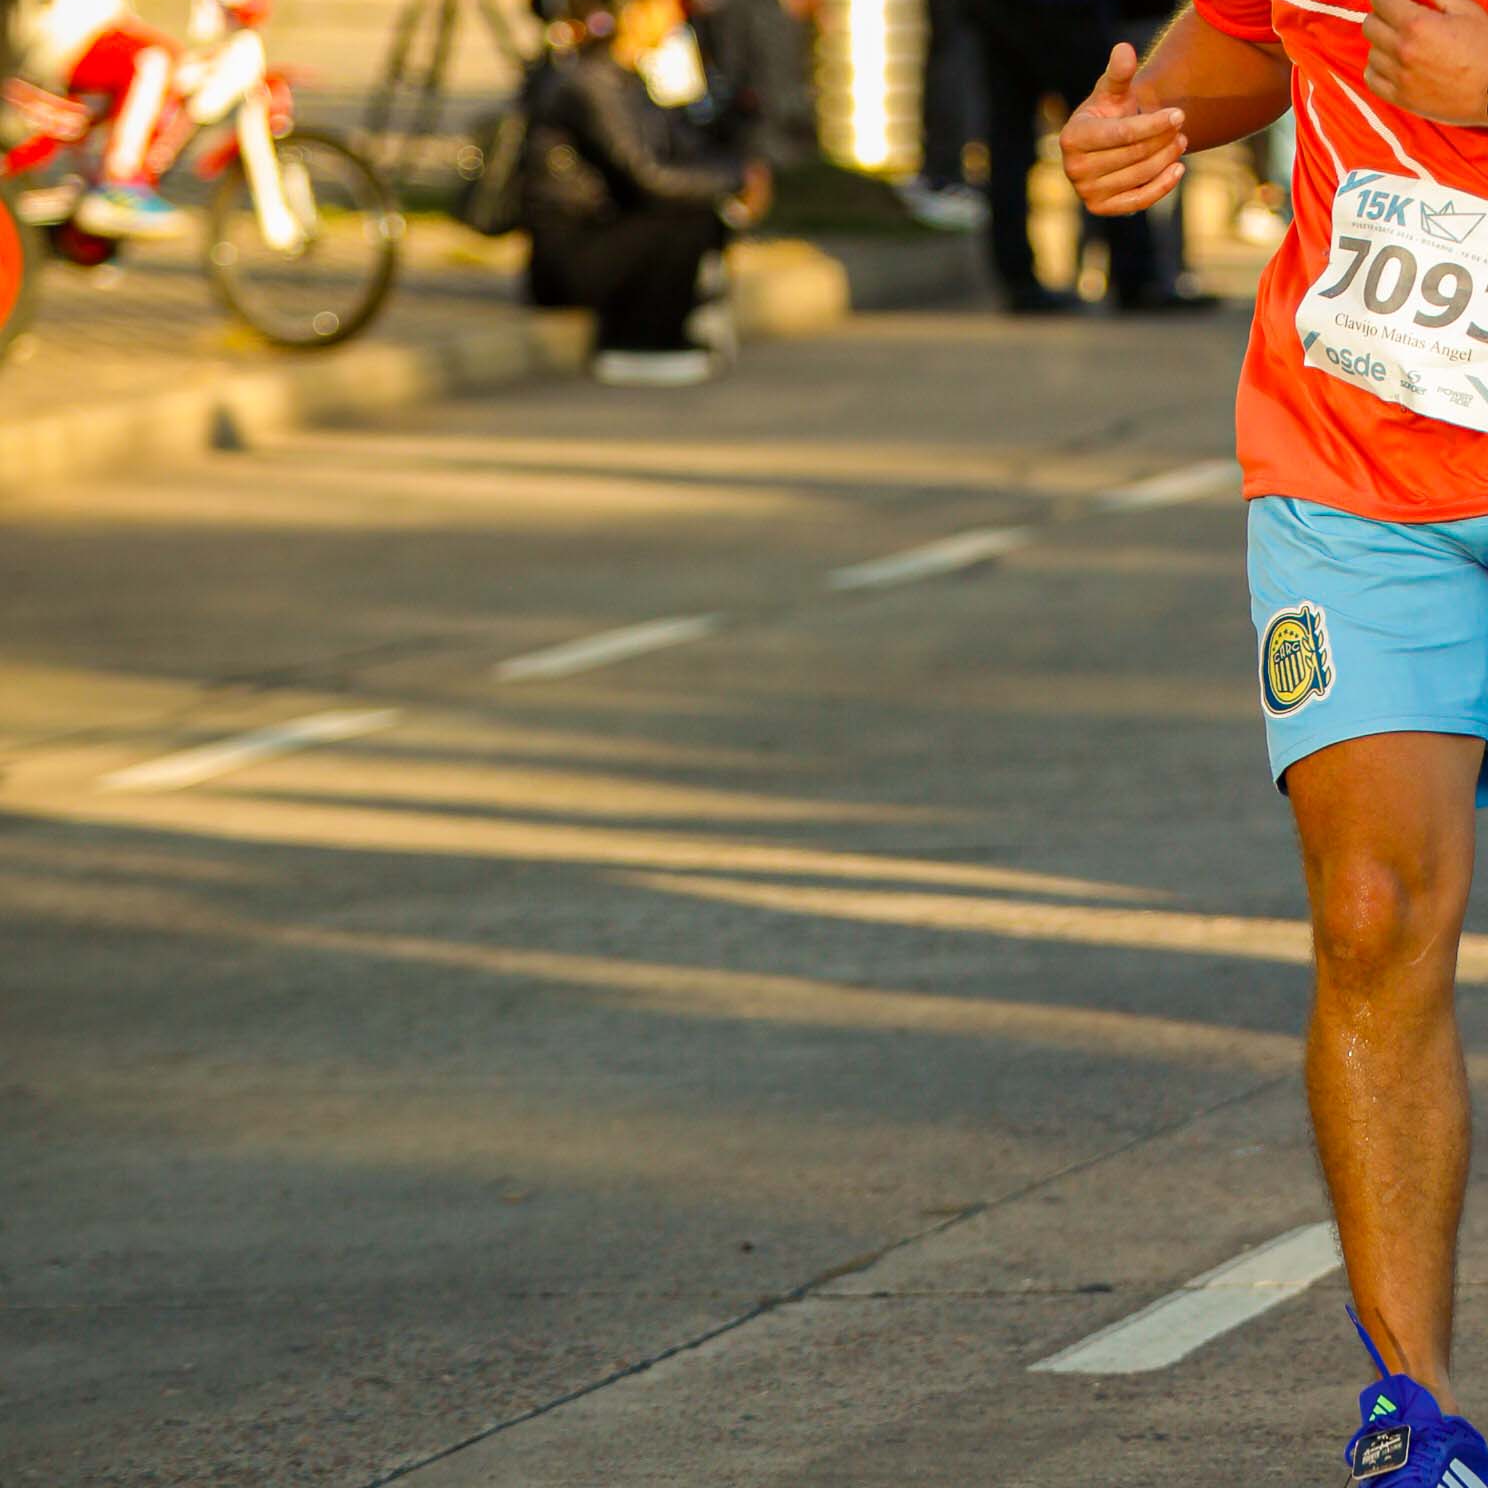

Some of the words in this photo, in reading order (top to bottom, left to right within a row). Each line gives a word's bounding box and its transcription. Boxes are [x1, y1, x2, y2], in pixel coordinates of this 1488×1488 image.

[1356, 188, 1416, 227] 15K
[1334, 312, 1379, 337] Clavijo
[1430, 340, 1473, 363] Angel
[1326, 346, 1387, 382] osde
[1274, 641, 1300, 663] CARC
